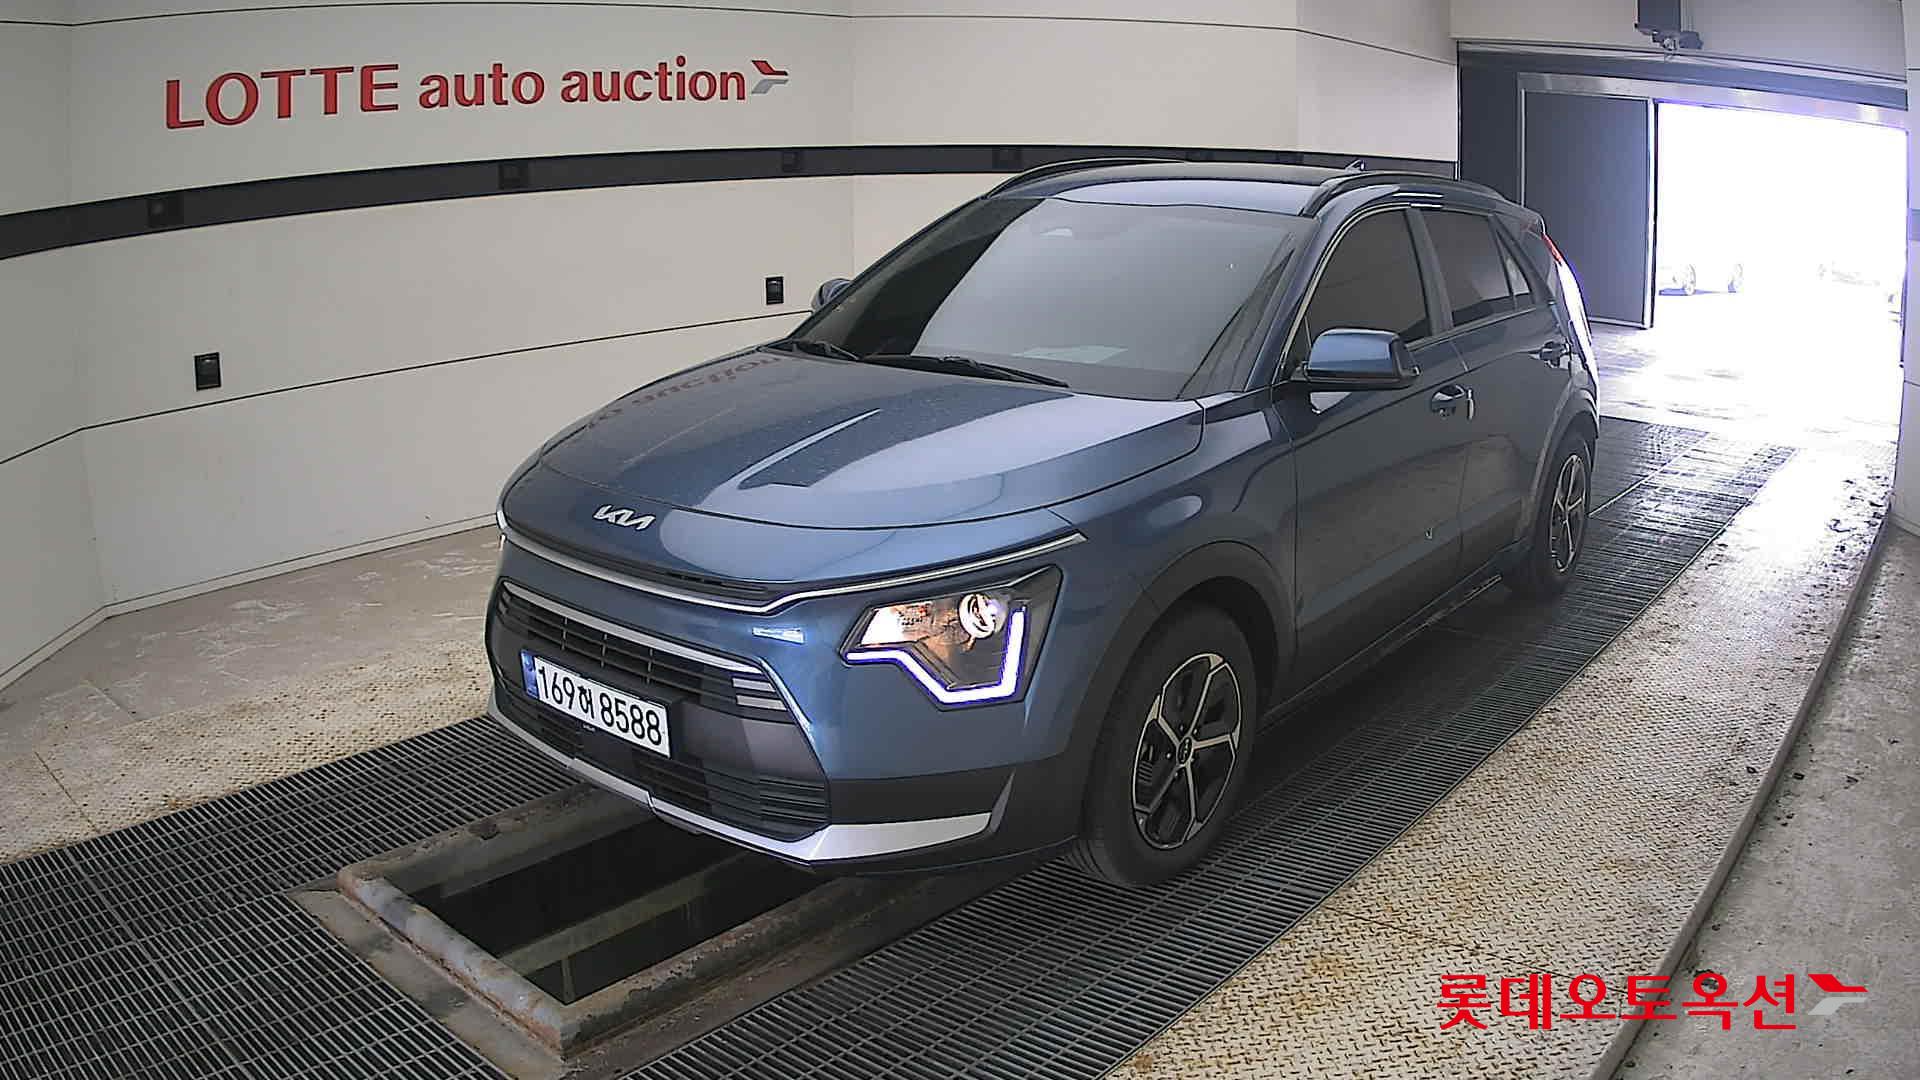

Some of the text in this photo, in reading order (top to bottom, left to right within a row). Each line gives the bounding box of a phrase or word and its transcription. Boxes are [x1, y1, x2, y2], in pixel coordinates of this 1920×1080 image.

[165, 55, 747, 130] LOTTE auto auction
[593, 504, 656, 531] KIA
[538, 666, 662, 746] 169허 8588
